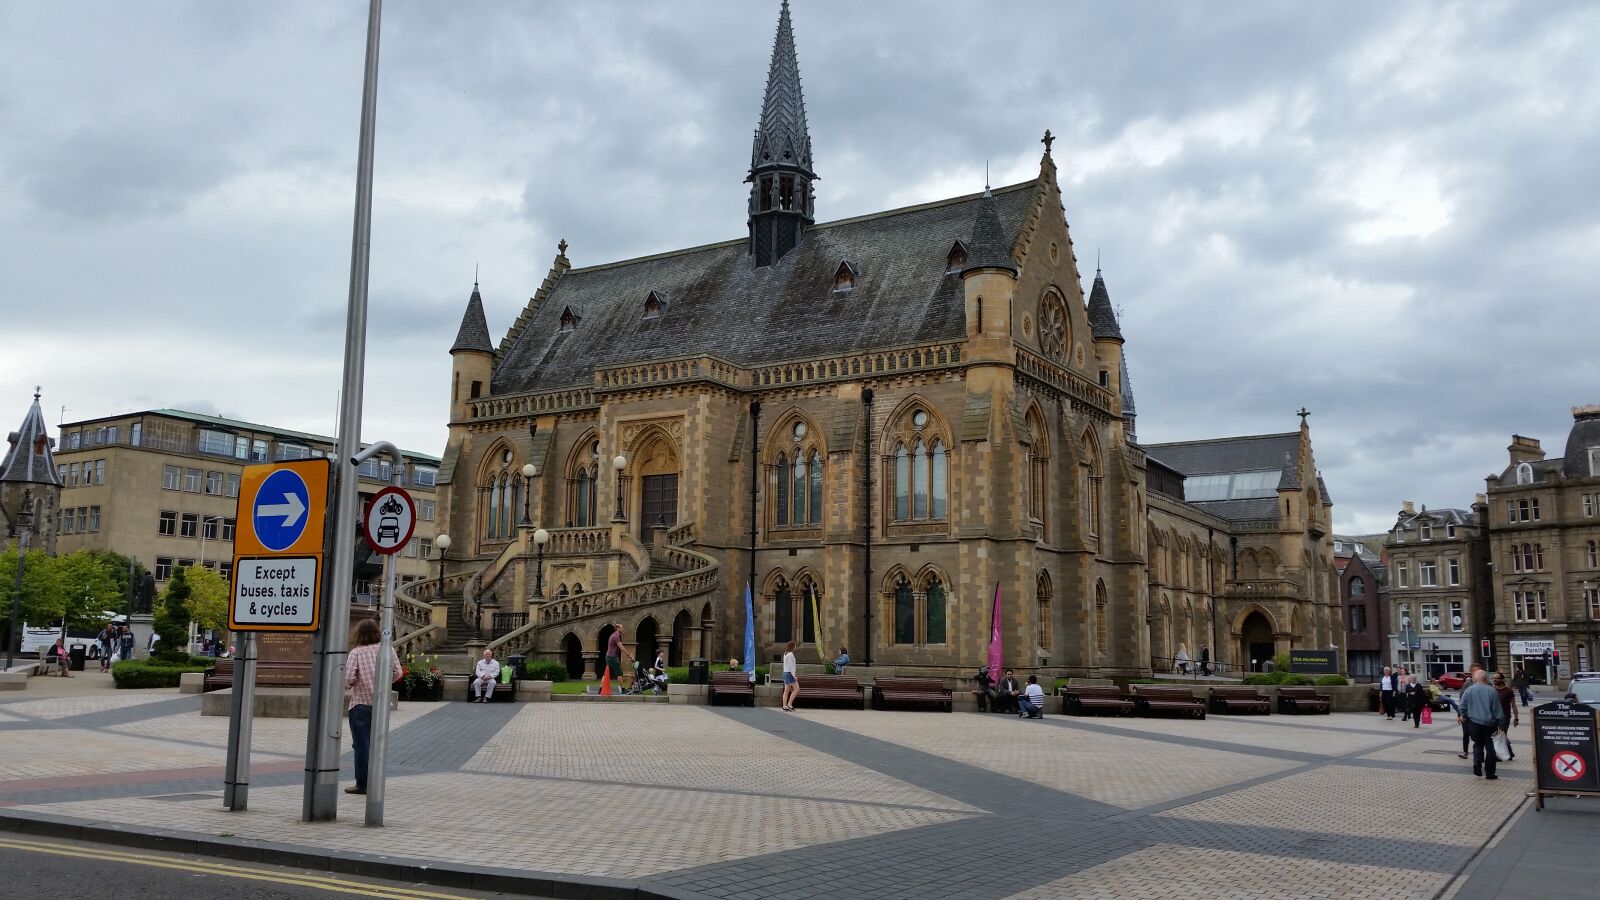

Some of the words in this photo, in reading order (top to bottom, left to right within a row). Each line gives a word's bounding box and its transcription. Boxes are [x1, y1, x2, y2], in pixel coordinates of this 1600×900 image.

[255, 566, 296, 581] Except
[281, 584, 310, 598] taxis
[249, 602, 256, 615] &
[260, 602, 298, 618] cycles
